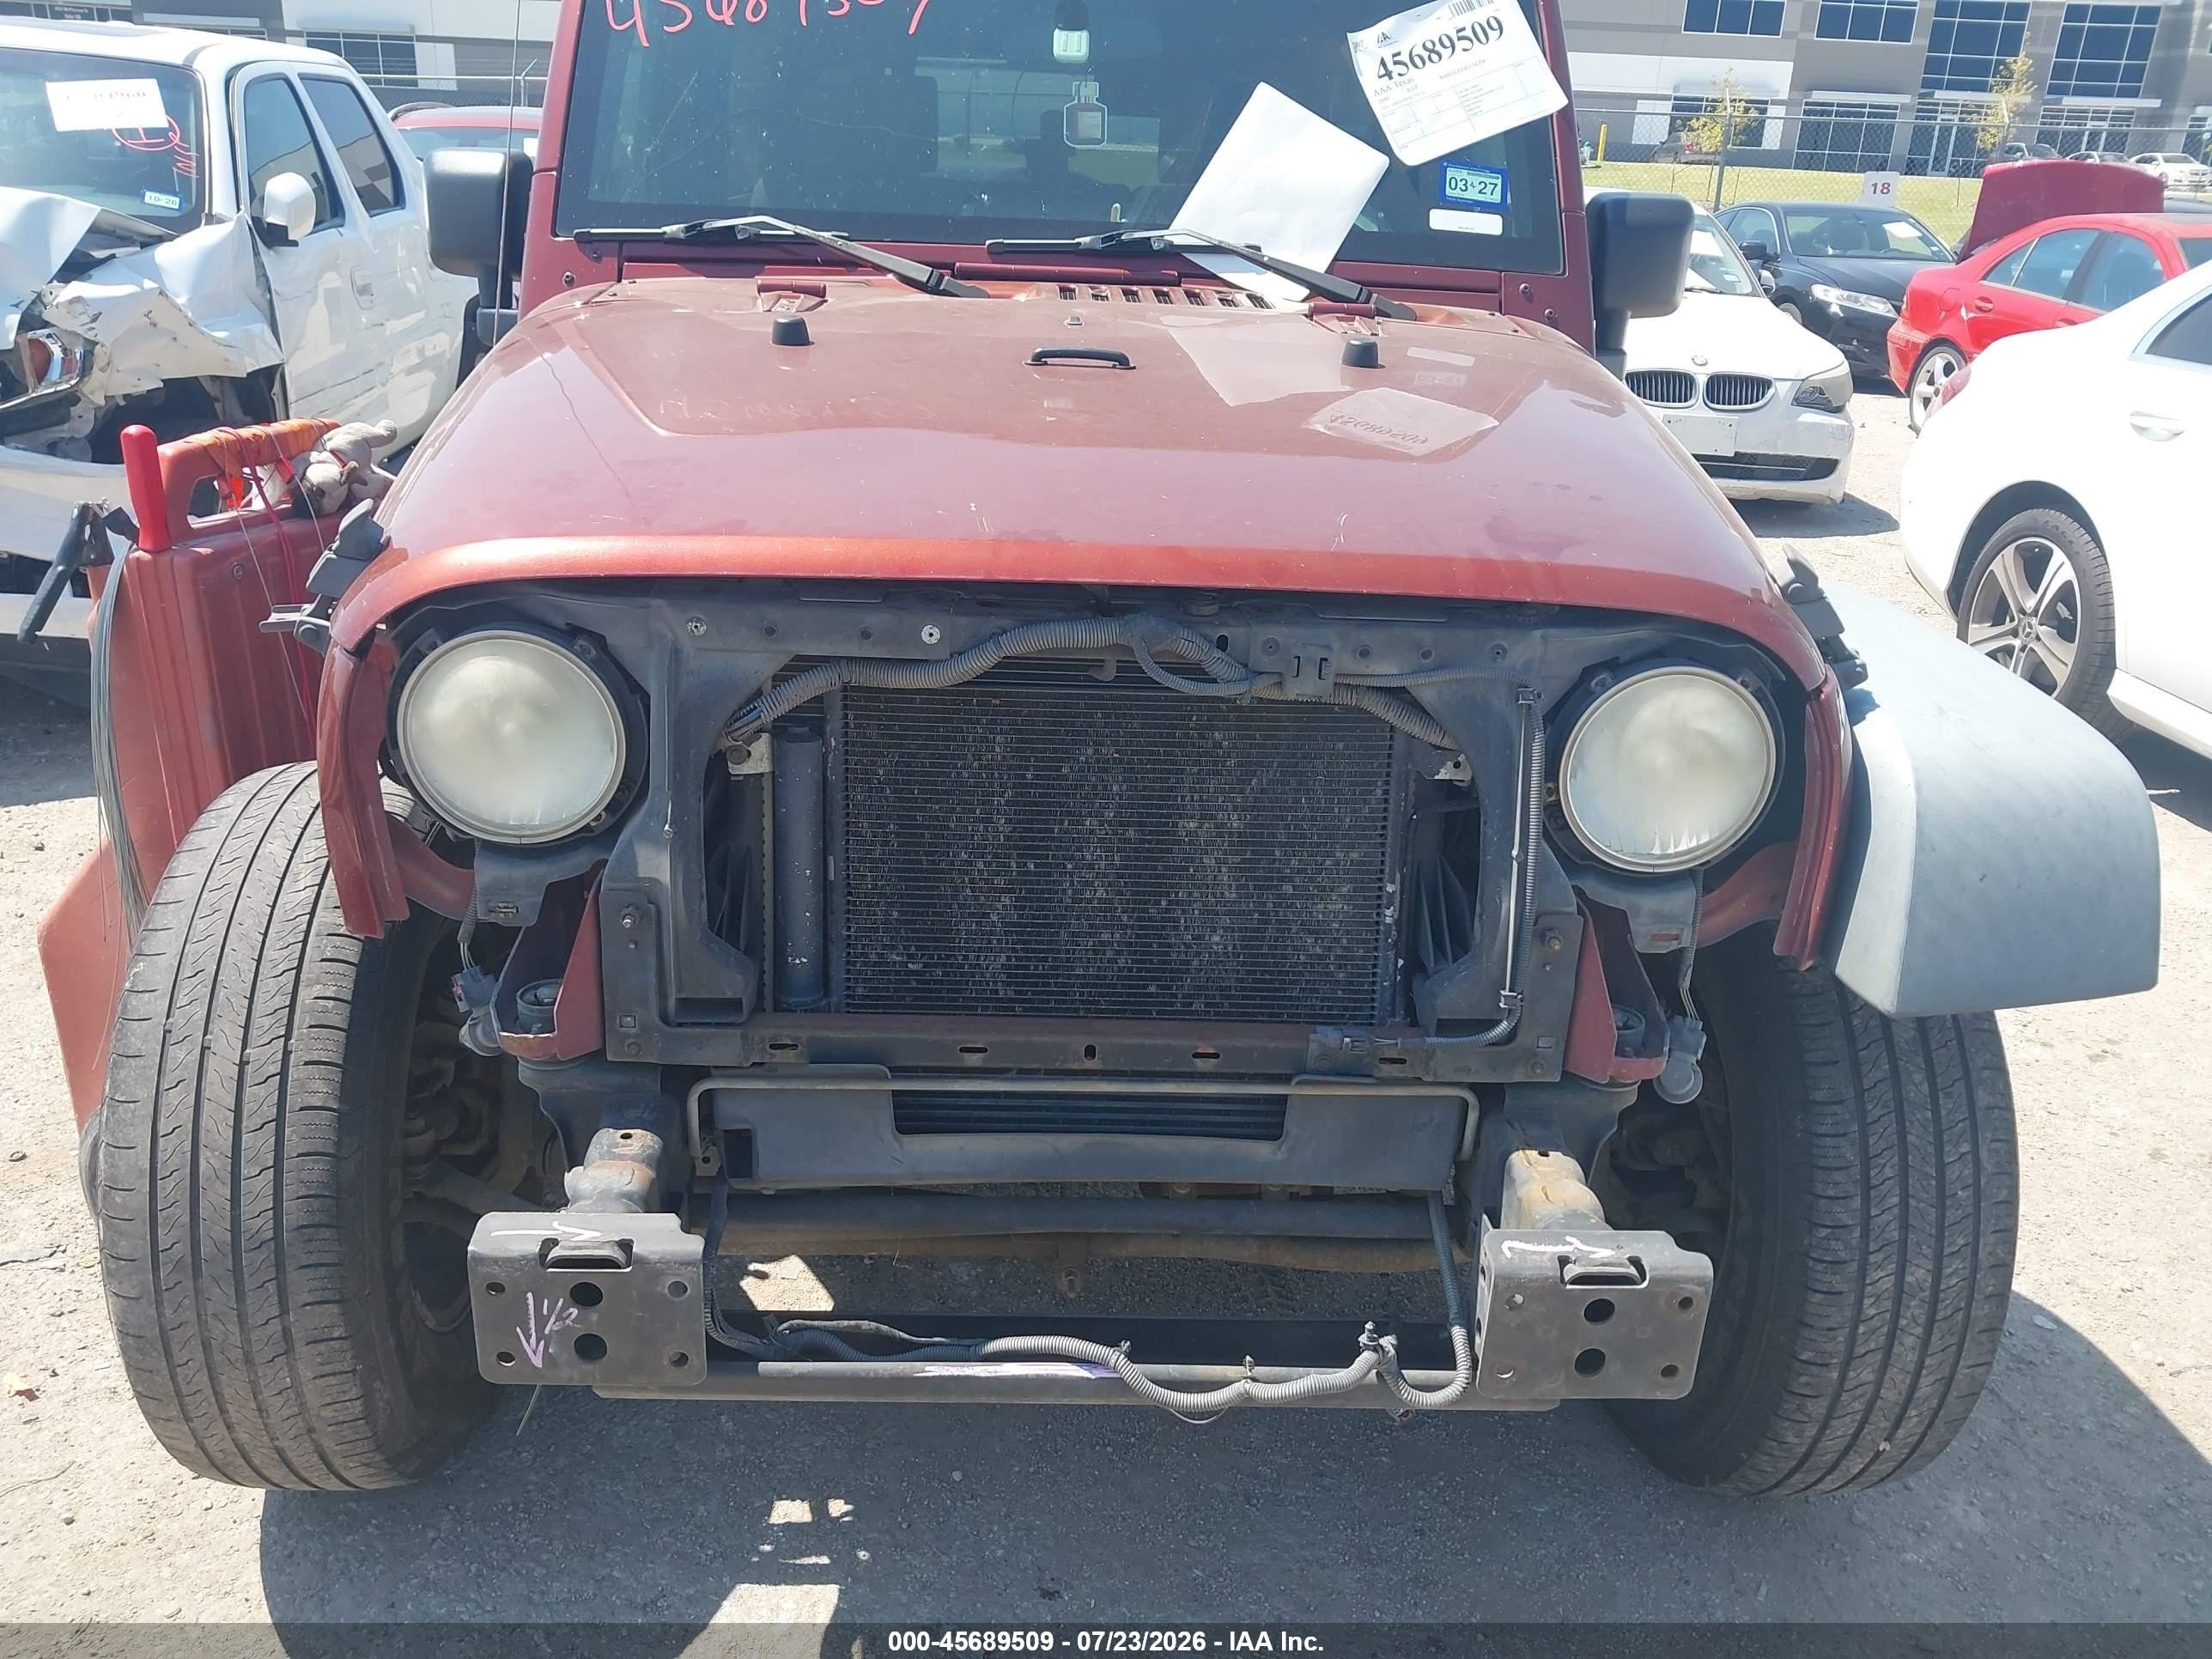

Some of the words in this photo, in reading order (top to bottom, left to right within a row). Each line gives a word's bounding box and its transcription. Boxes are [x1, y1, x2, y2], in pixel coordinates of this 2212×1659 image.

[1377, 15, 1504, 81] 45689509
[1449, 176, 1468, 192] 03
[1478, 180, 1498, 197] 27
[1871, 182, 1890, 195] 18
[543, 1297, 581, 1334] 1/2
